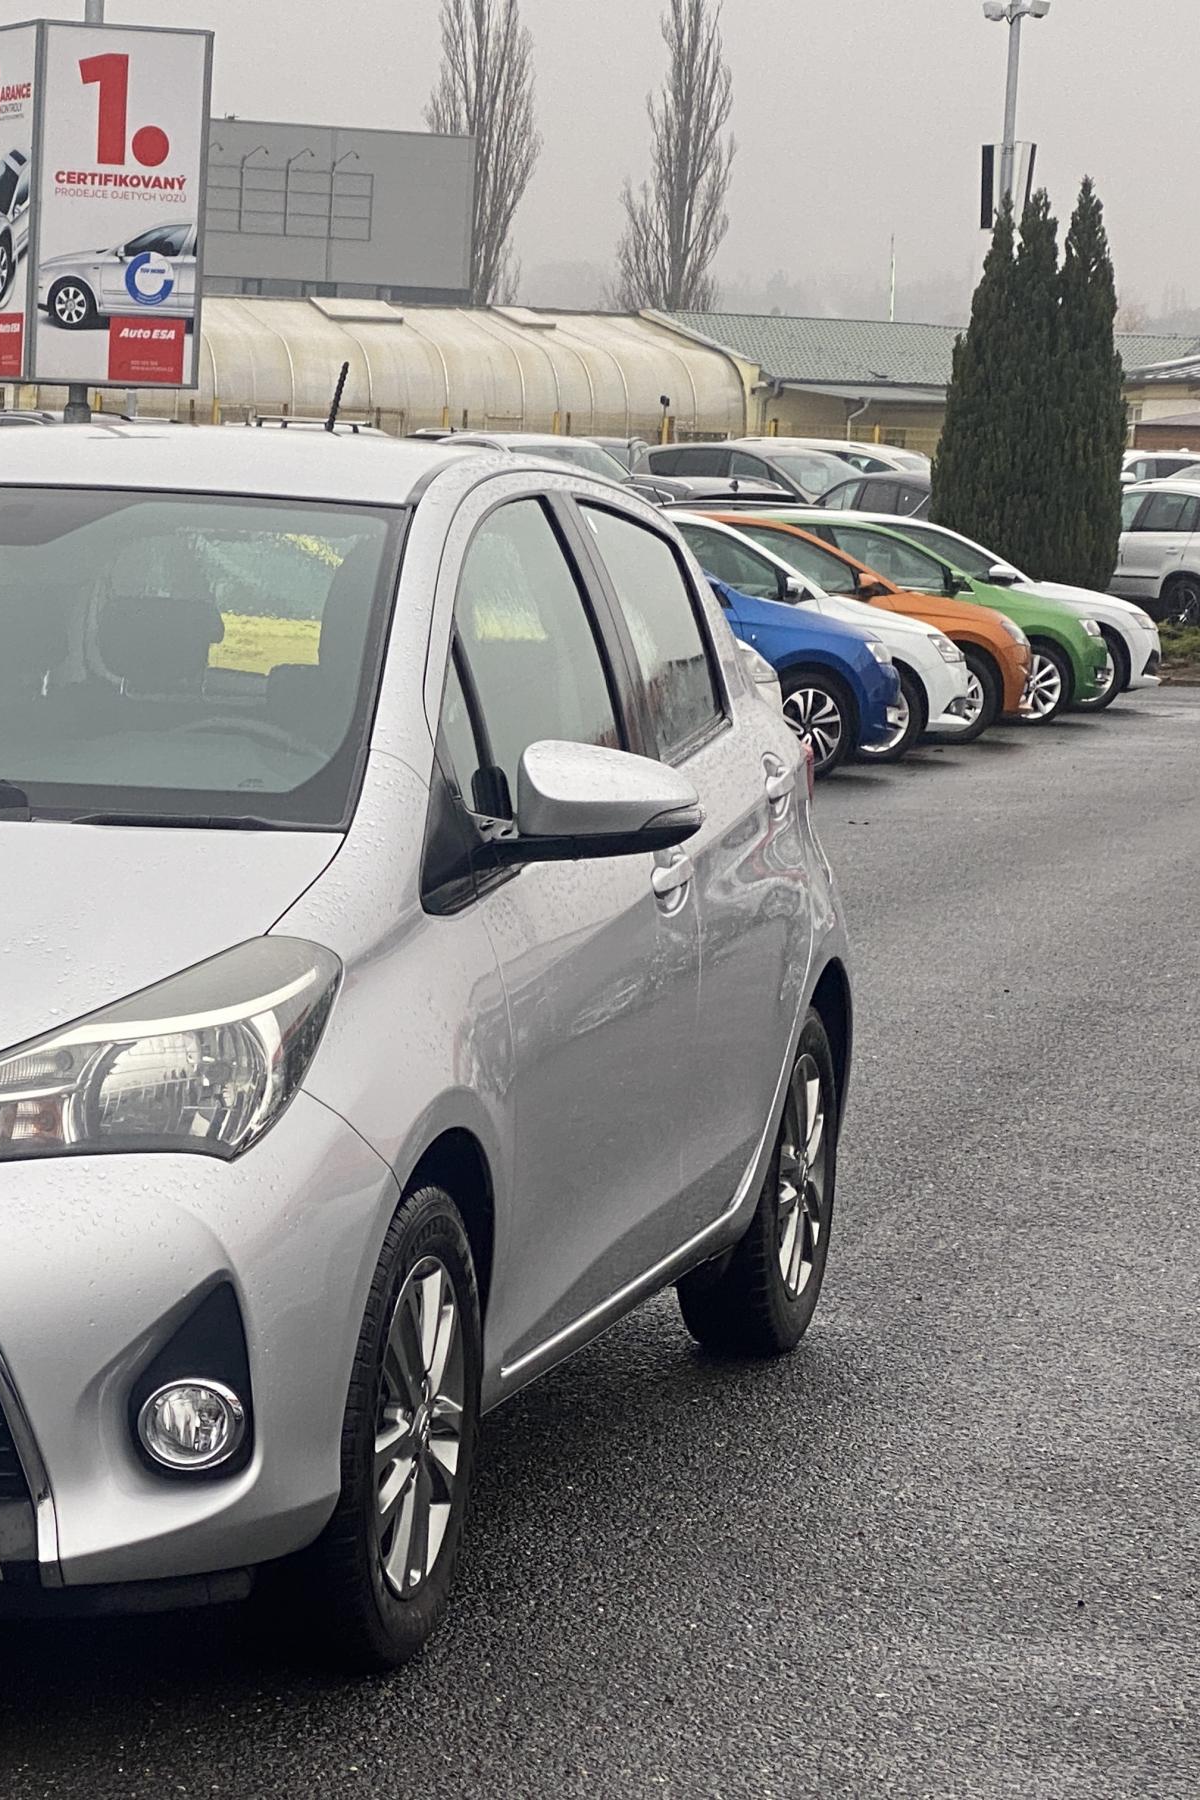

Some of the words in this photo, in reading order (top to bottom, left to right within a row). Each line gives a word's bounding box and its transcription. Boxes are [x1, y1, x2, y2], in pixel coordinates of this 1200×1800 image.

[78, 52, 170, 167] 1.
[54, 170, 188, 191] CERTIFIKOVANÝ
[54, 186, 109, 200] PRODEJCE
[119, 327, 152, 339] Auto
[151, 328, 177, 340] ESA
